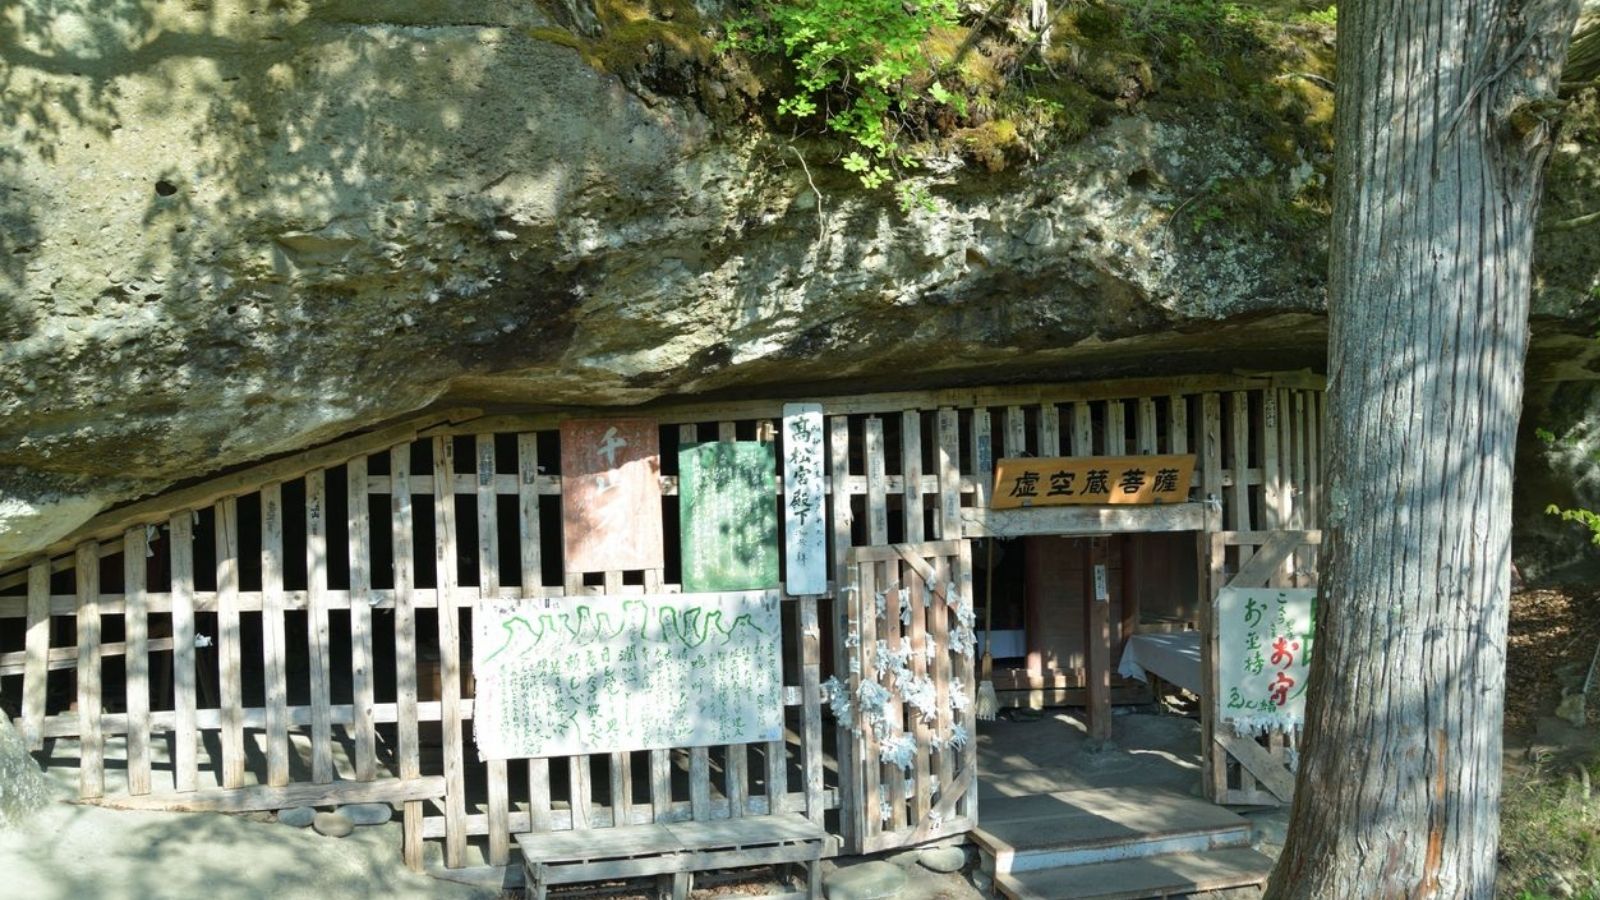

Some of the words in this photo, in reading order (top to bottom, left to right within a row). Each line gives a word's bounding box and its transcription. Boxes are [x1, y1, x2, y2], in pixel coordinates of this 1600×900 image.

[1009, 468, 1180, 498] 虚空蔵菩薩
